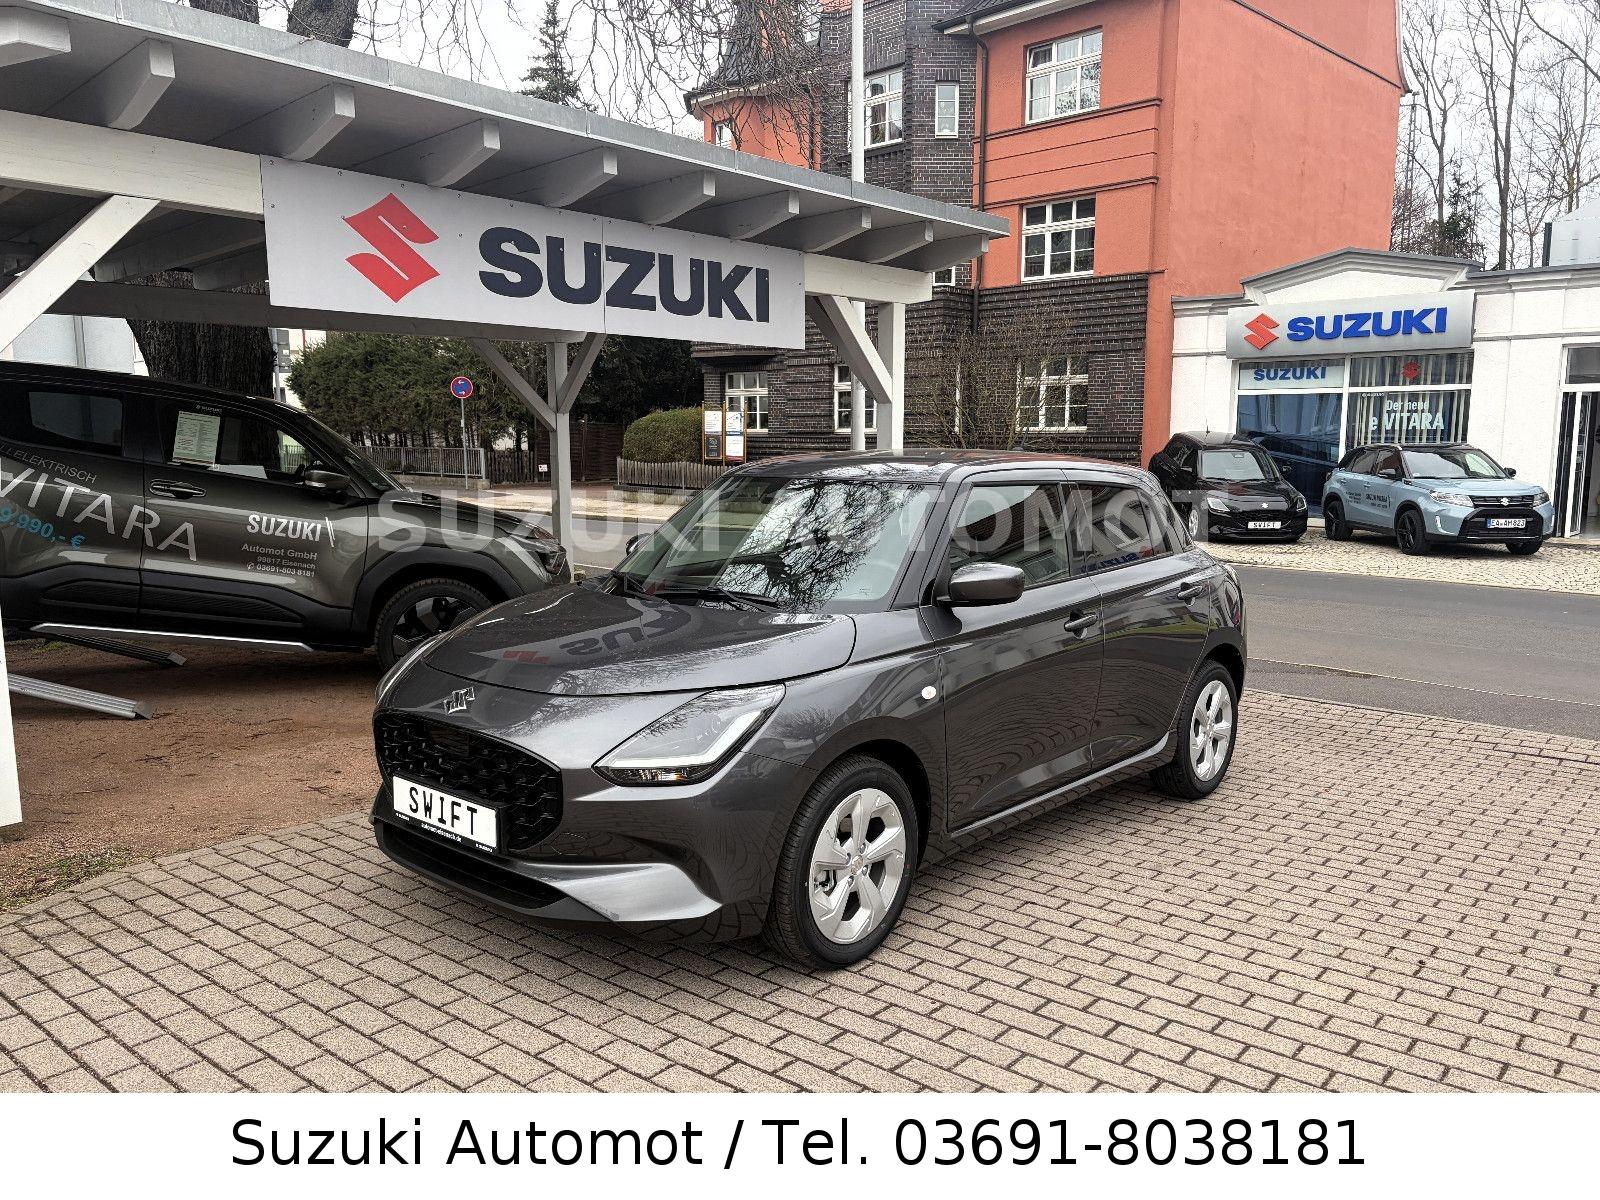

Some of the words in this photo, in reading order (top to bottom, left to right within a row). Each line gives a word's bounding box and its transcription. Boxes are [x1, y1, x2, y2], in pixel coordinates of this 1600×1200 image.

[478, 226, 770, 323] SUZUKI
[1286, 306, 1448, 342] SUZUKI
[1253, 367, 1327, 381] SUZUKI
[1385, 400, 1404, 411] Der
[1385, 412, 1445, 430] VITARA
[246, 514, 321, 541] SUZUKI
[241, 543, 285, 556] Automot
[287, 549, 318, 561] GmbH
[408, 786, 478, 836] SWIFT
